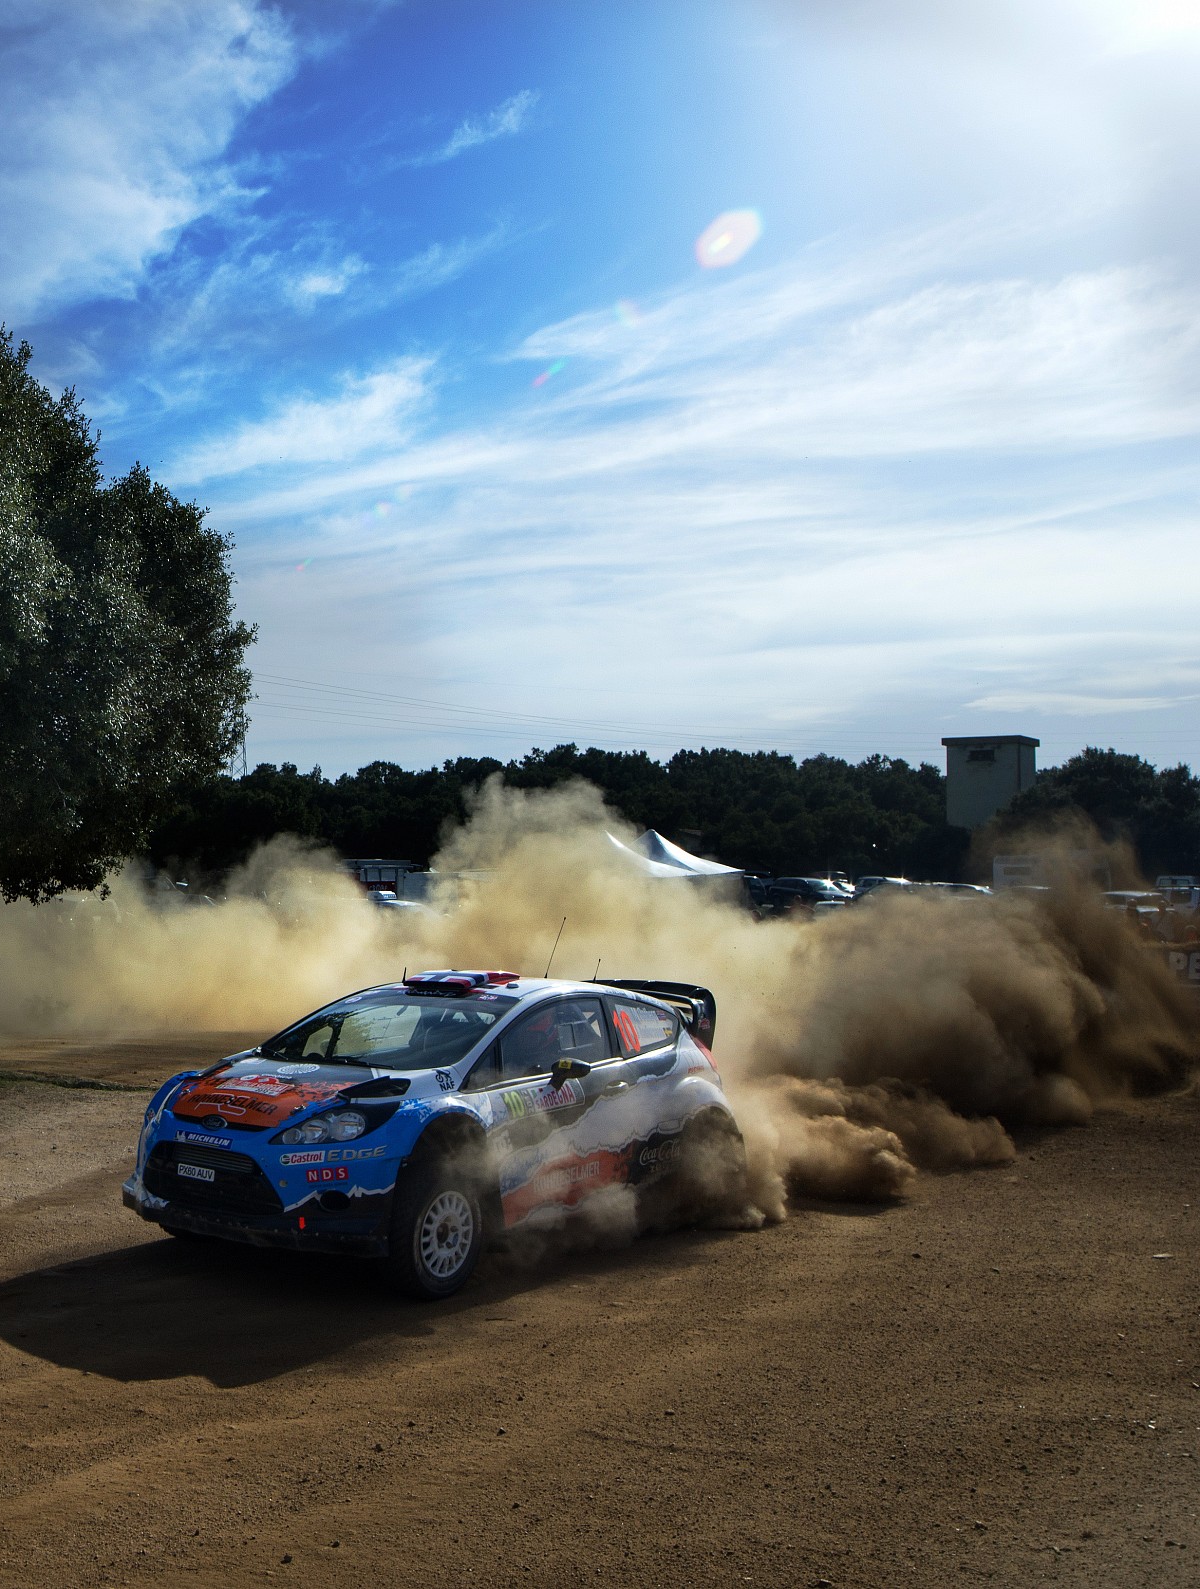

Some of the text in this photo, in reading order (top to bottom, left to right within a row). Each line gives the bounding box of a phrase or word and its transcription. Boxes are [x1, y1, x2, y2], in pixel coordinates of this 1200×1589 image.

[613, 1010, 641, 1052] 10
[439, 1081, 455, 1092] NAF
[535, 1083, 576, 1109] SARDEGNA
[504, 1090, 525, 1118] 10
[187, 1134, 230, 1147] MICHELIN
[290, 1145, 388, 1164] Castrol EDGE
[179, 1165, 213, 1180] PX60 AUV
